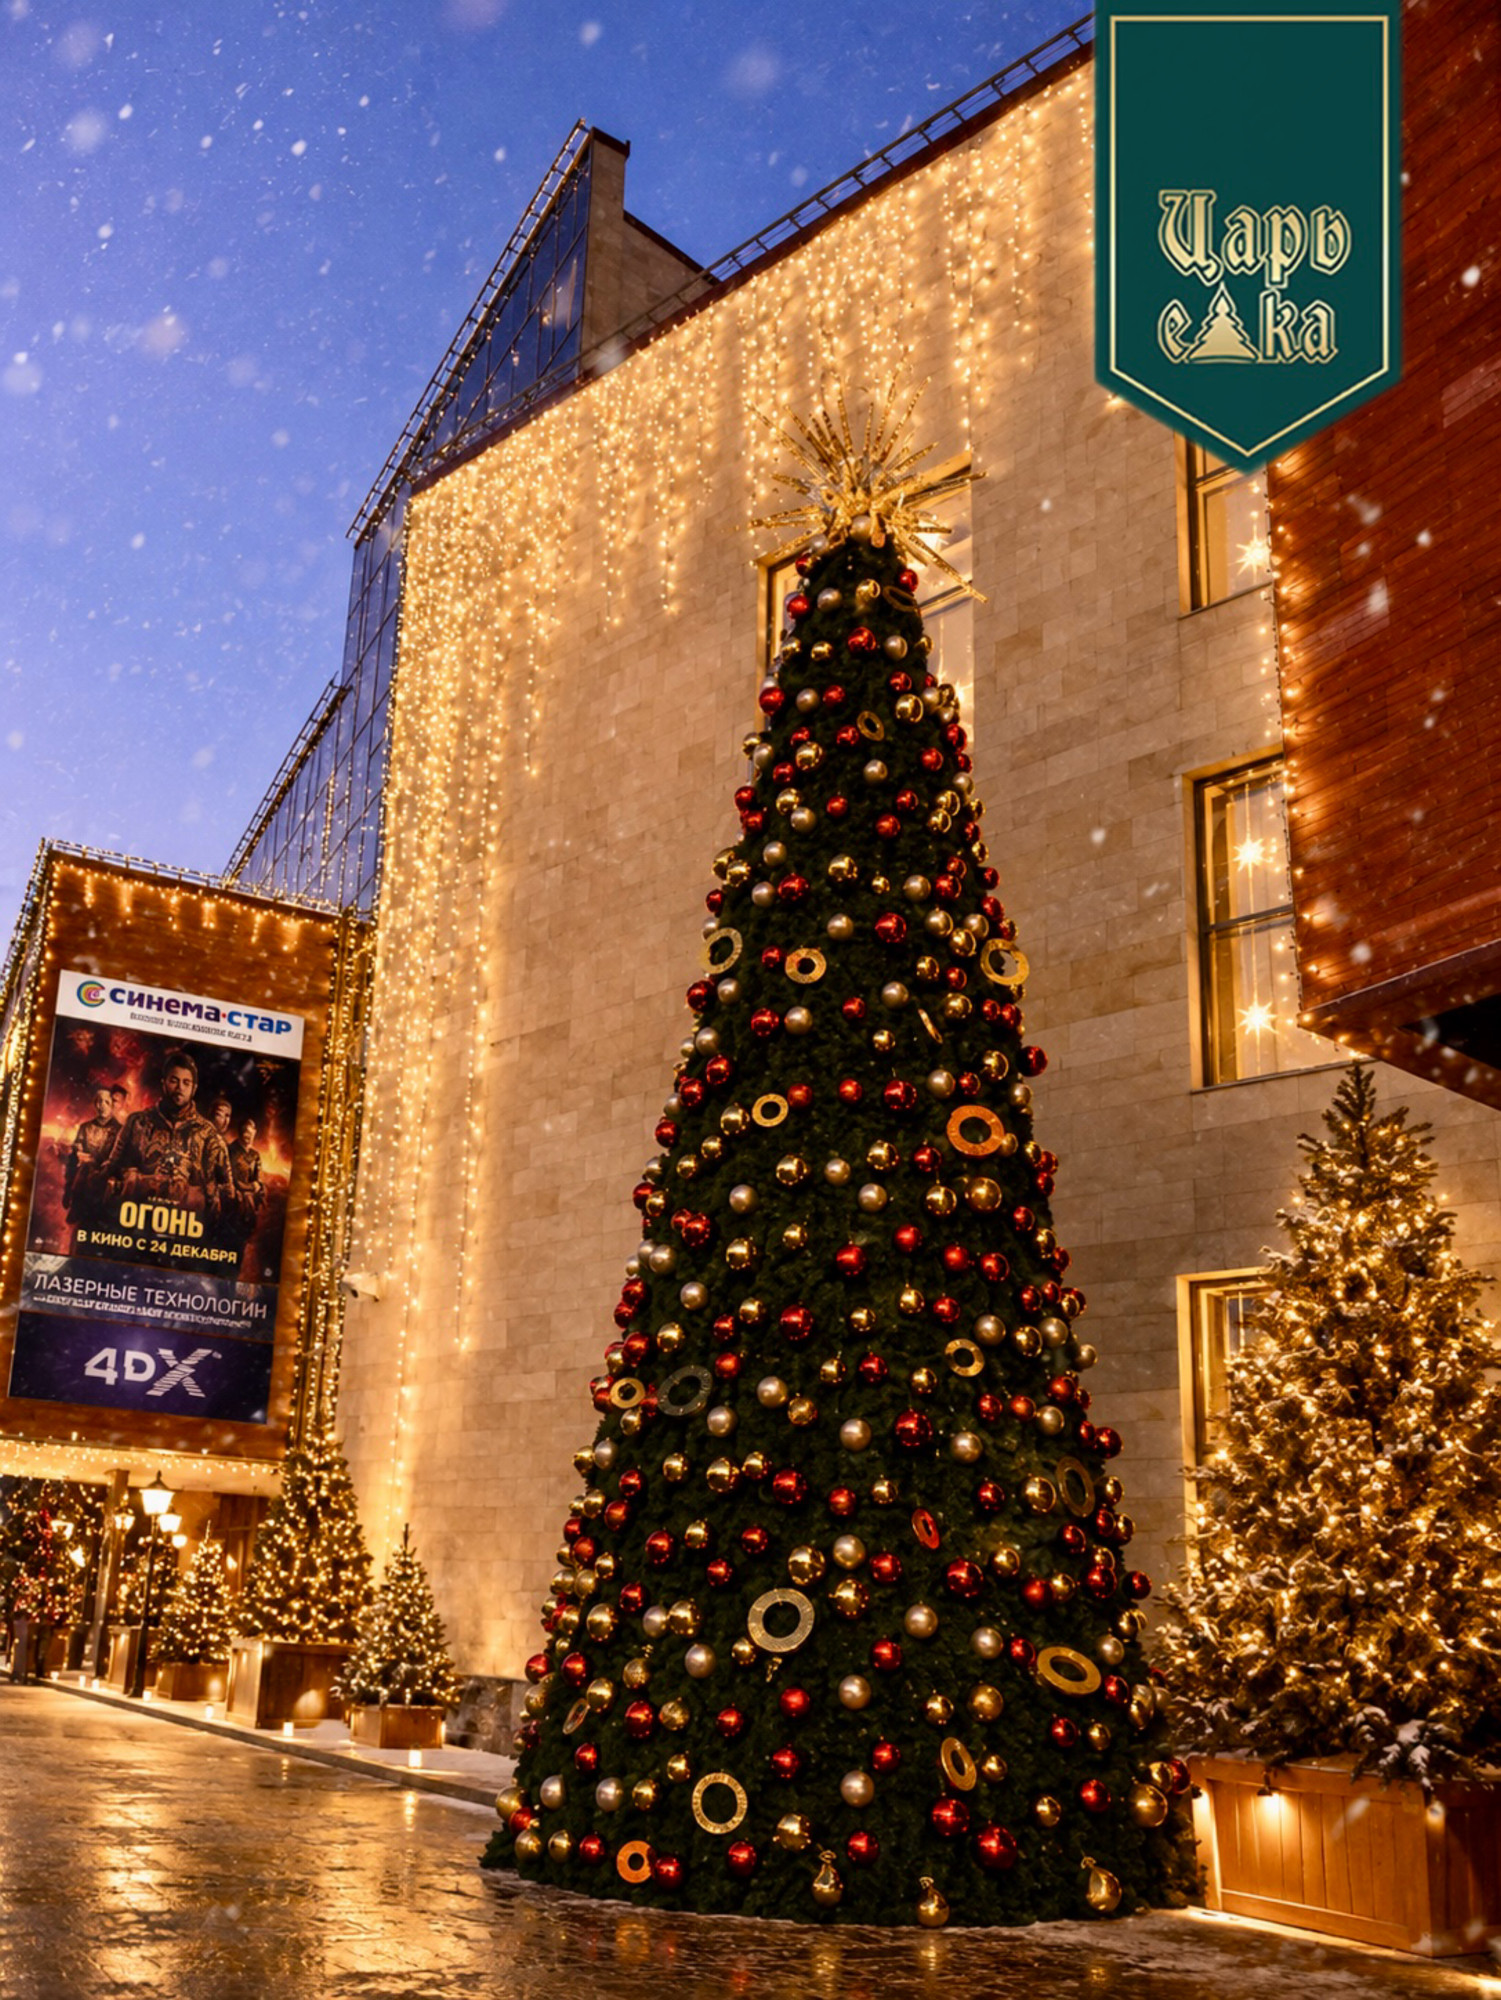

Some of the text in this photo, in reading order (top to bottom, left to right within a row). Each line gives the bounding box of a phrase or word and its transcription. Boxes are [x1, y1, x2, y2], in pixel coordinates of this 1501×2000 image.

[119, 1201, 204, 1238] ОГОНЬ
[77, 1229, 238, 1264] В КИНО С 24 ДЕКАБРЯ
[33, 1273, 138, 1302] ЛАЗЕРНЫЕ
[84, 1347, 206, 1398] 4DX
